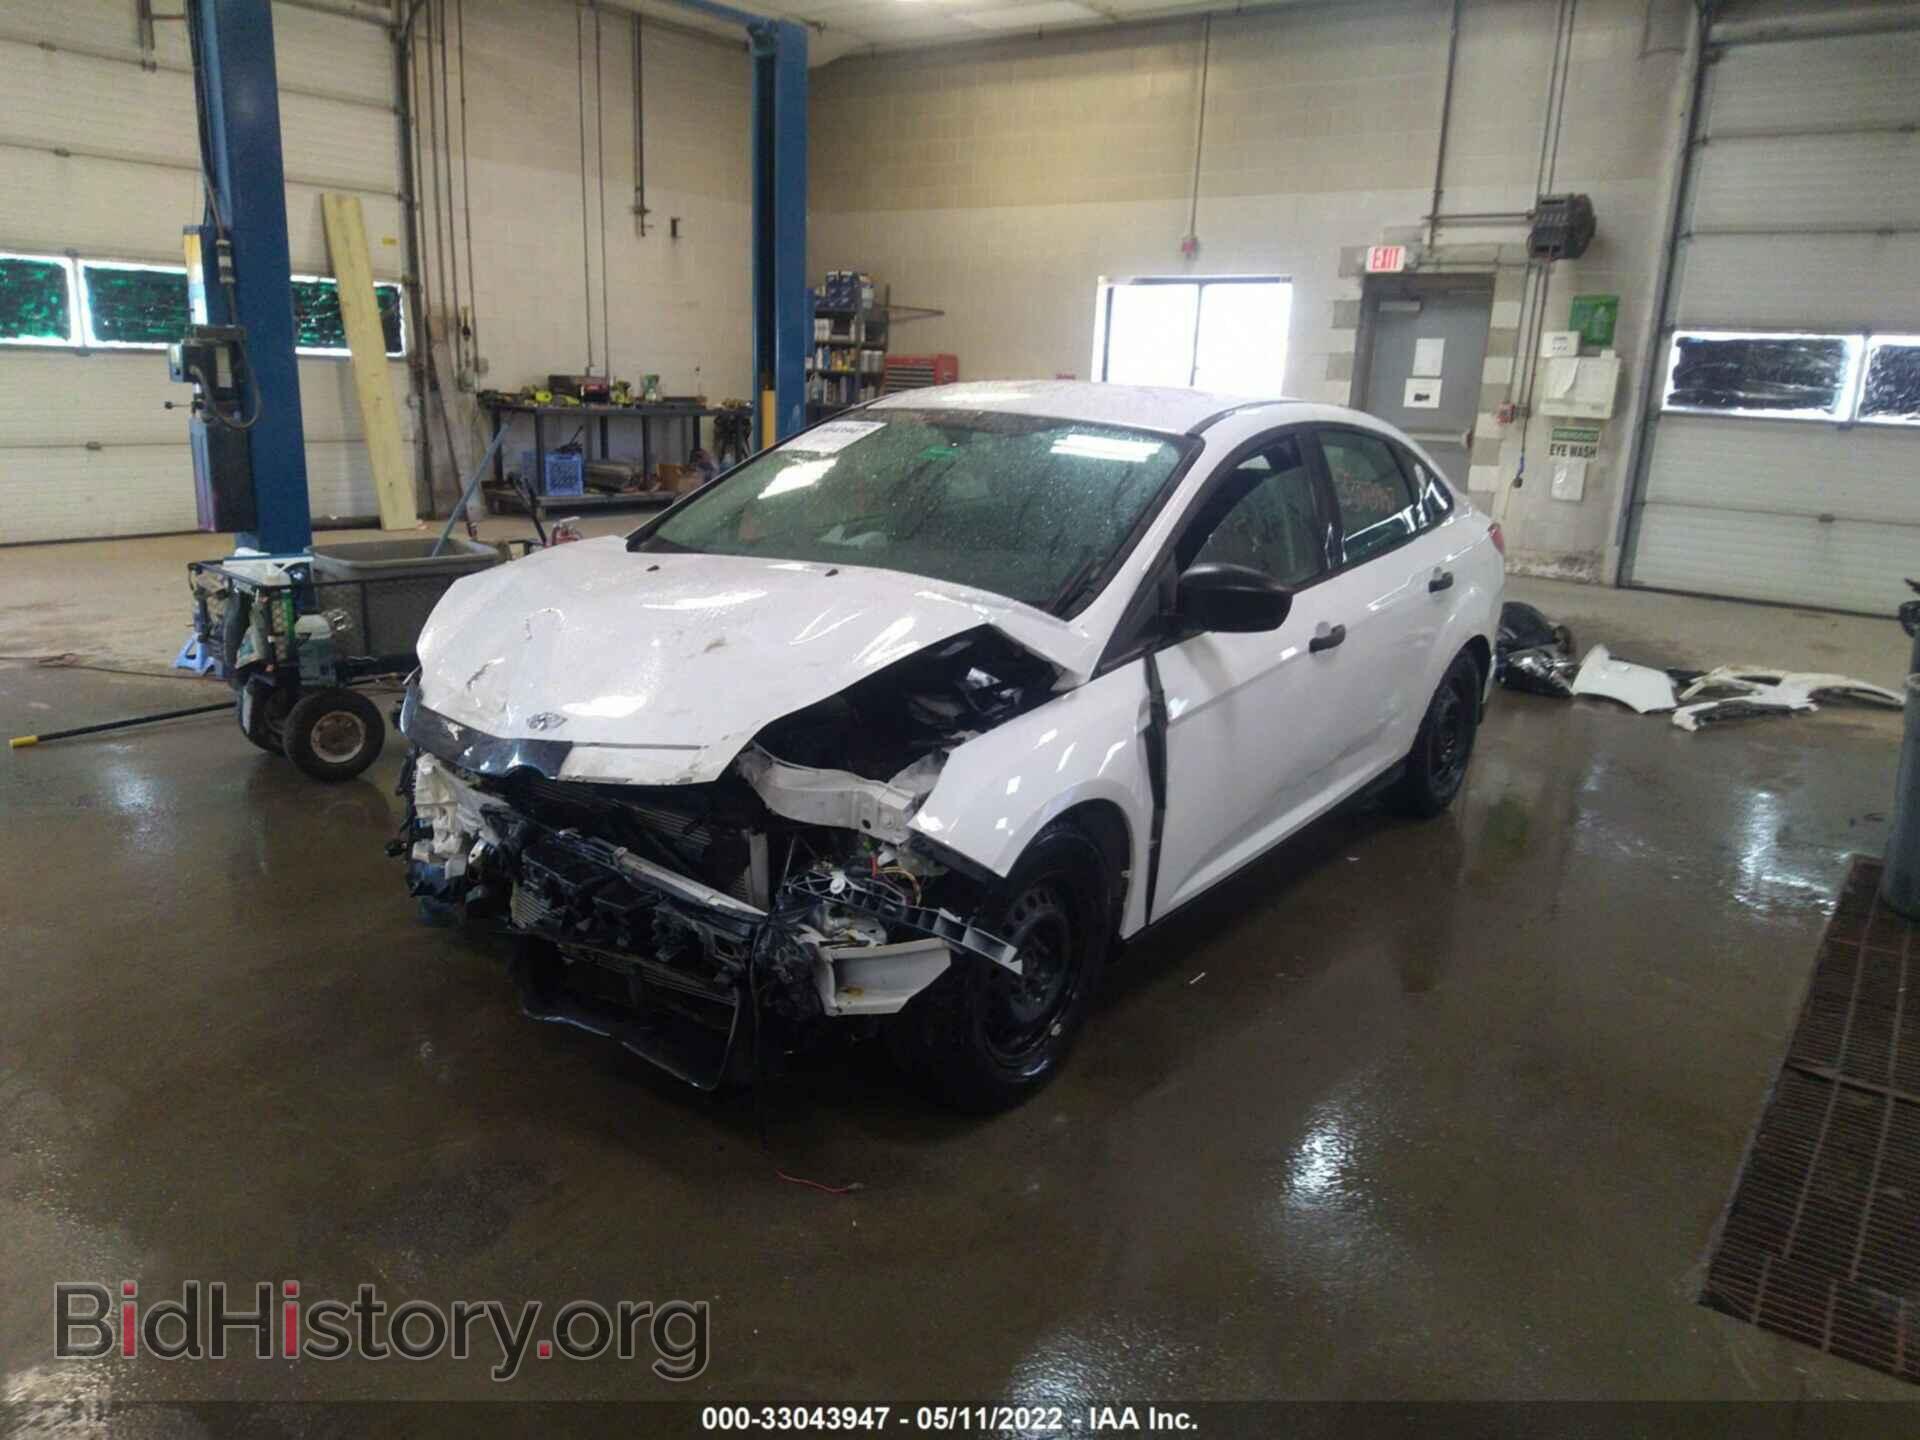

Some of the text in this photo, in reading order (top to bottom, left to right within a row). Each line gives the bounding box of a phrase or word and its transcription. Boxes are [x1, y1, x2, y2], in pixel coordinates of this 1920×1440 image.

[1371, 247, 1401, 270] EXIT
[1549, 443, 1597, 459] EYE WASH
